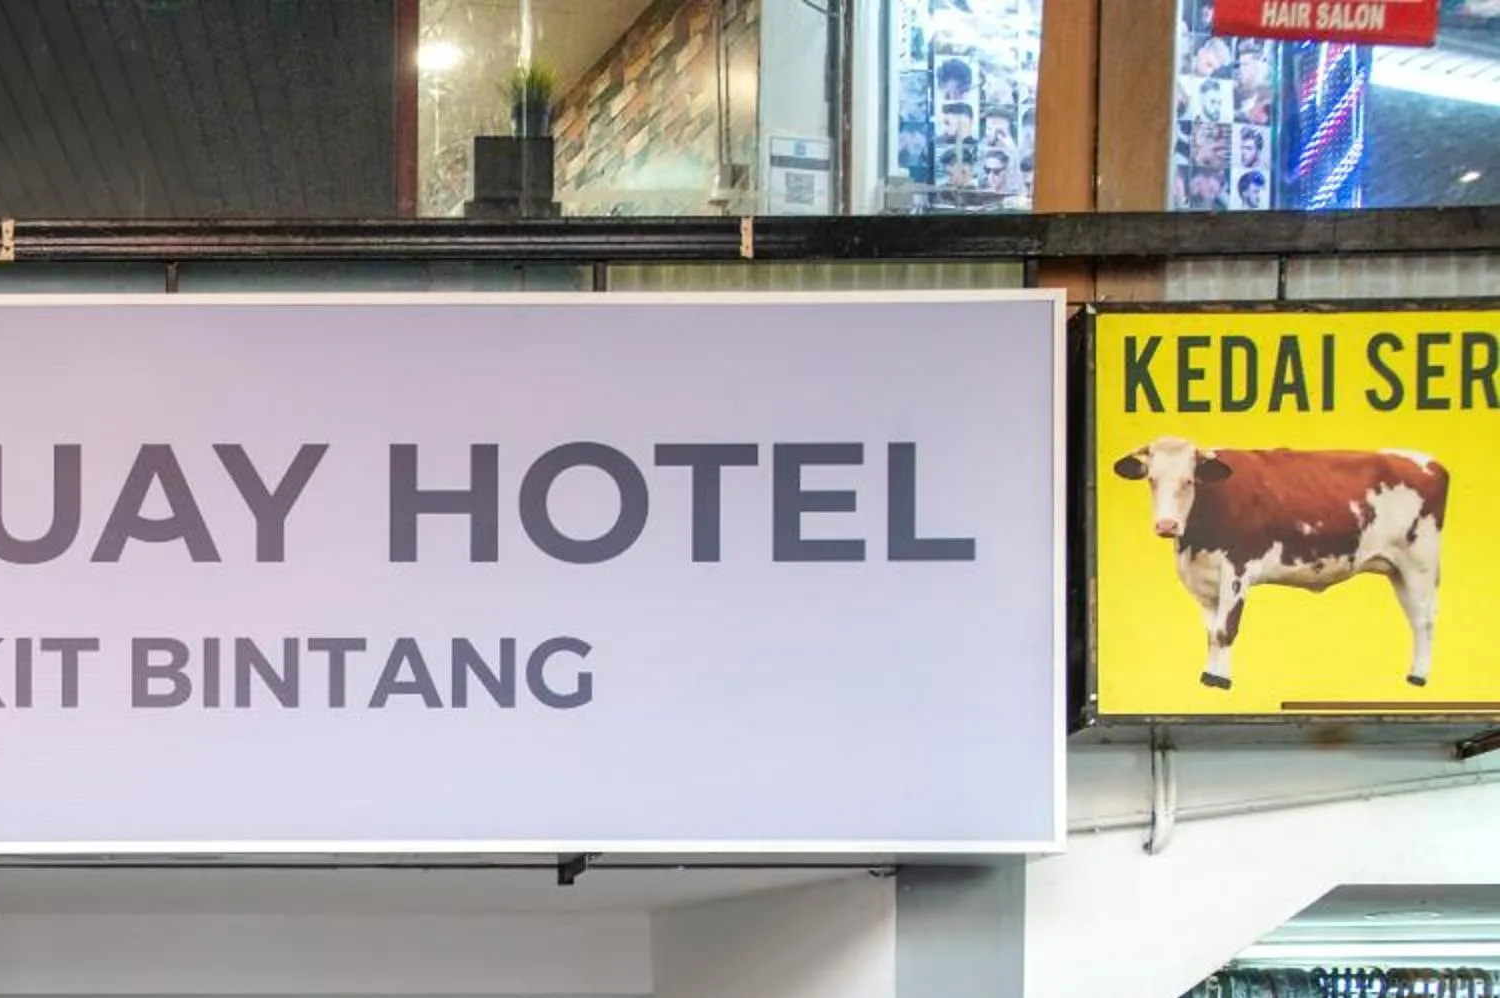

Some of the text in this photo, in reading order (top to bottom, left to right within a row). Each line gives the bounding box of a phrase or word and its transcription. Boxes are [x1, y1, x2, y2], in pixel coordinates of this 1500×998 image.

[1261, 2, 1386, 30] HAIR SALON
[1124, 332, 1500, 413] KEDAI SER
[389, 441, 975, 564] HOTEL
[132, 637, 592, 708] BINTANG
